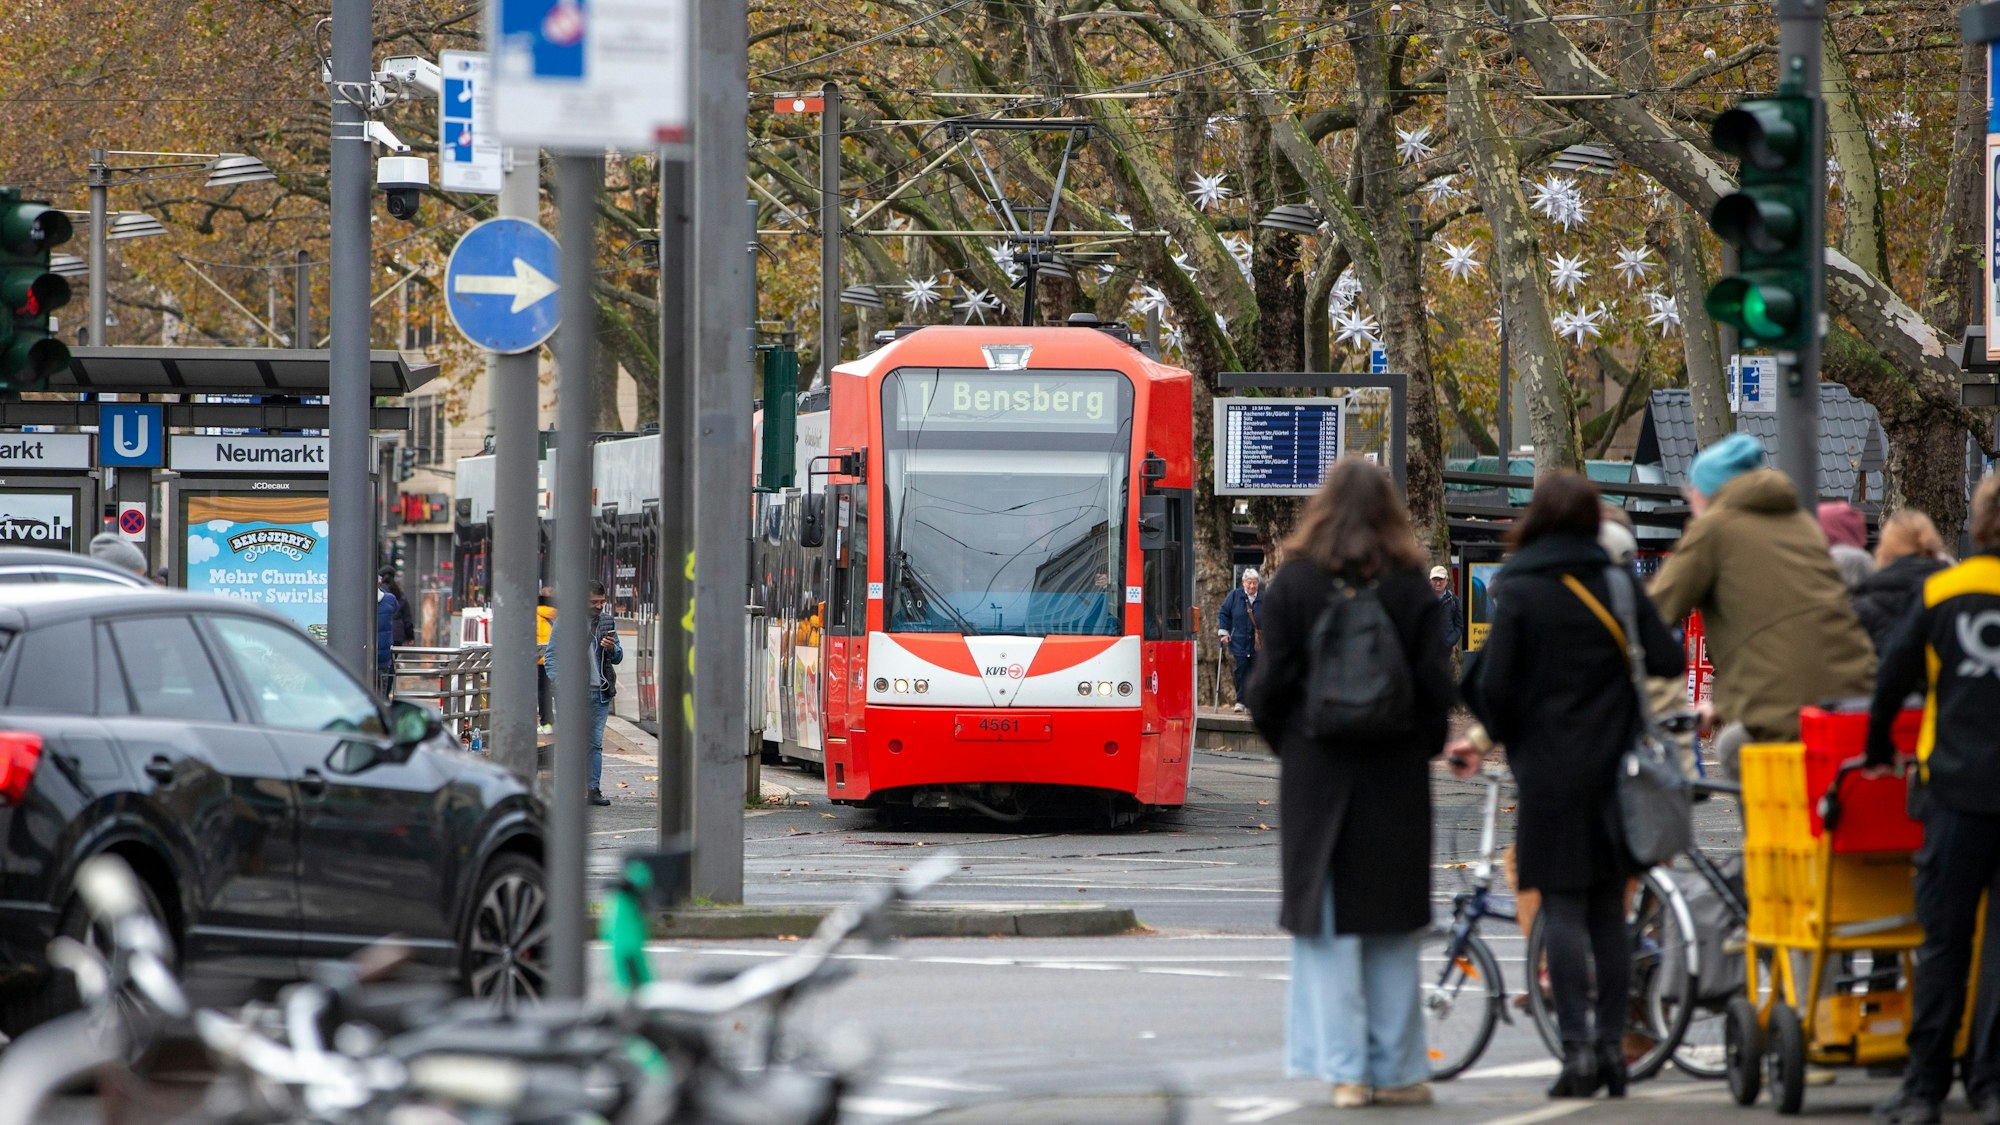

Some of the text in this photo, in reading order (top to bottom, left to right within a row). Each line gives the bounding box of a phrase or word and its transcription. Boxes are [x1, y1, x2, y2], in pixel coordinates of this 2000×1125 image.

[919, 381, 1103, 419] 1 Bensberg
[113, 414, 148, 458] U
[217, 444, 324, 462] Neumarkt
[244, 543, 303, 562] Sundae
[209, 569, 327, 585] Mehr Chunks
[214, 588, 262, 602] Mehr
[985, 666, 1007, 676] KVB
[979, 719, 1019, 732] 4561
